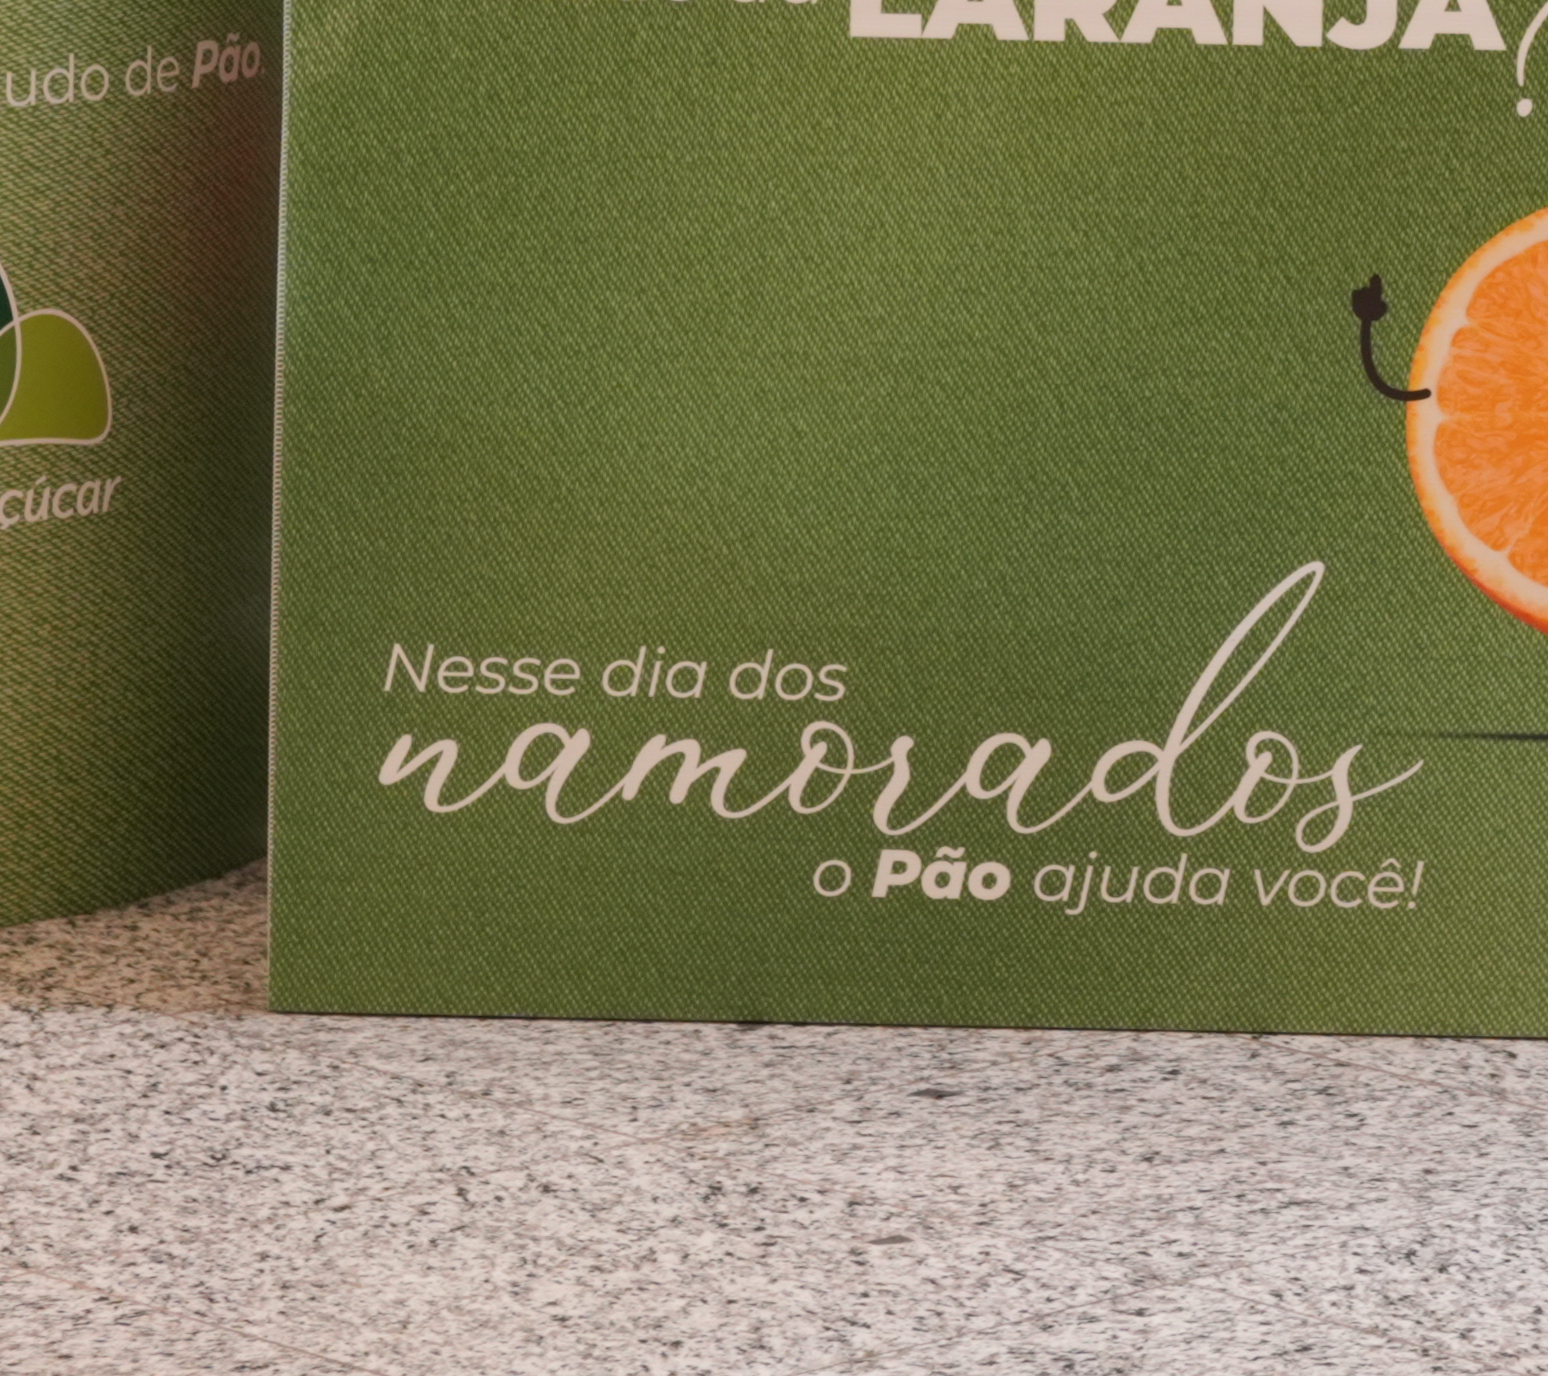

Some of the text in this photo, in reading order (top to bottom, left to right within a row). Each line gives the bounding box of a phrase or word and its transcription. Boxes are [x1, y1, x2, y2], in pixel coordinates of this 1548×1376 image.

[124, 45, 181, 98] de
[382, 641, 848, 703] Nesse dia dos
[377, 560, 1424, 853] namorados
[812, 846, 1425, 916] o Pão ajuda você!
